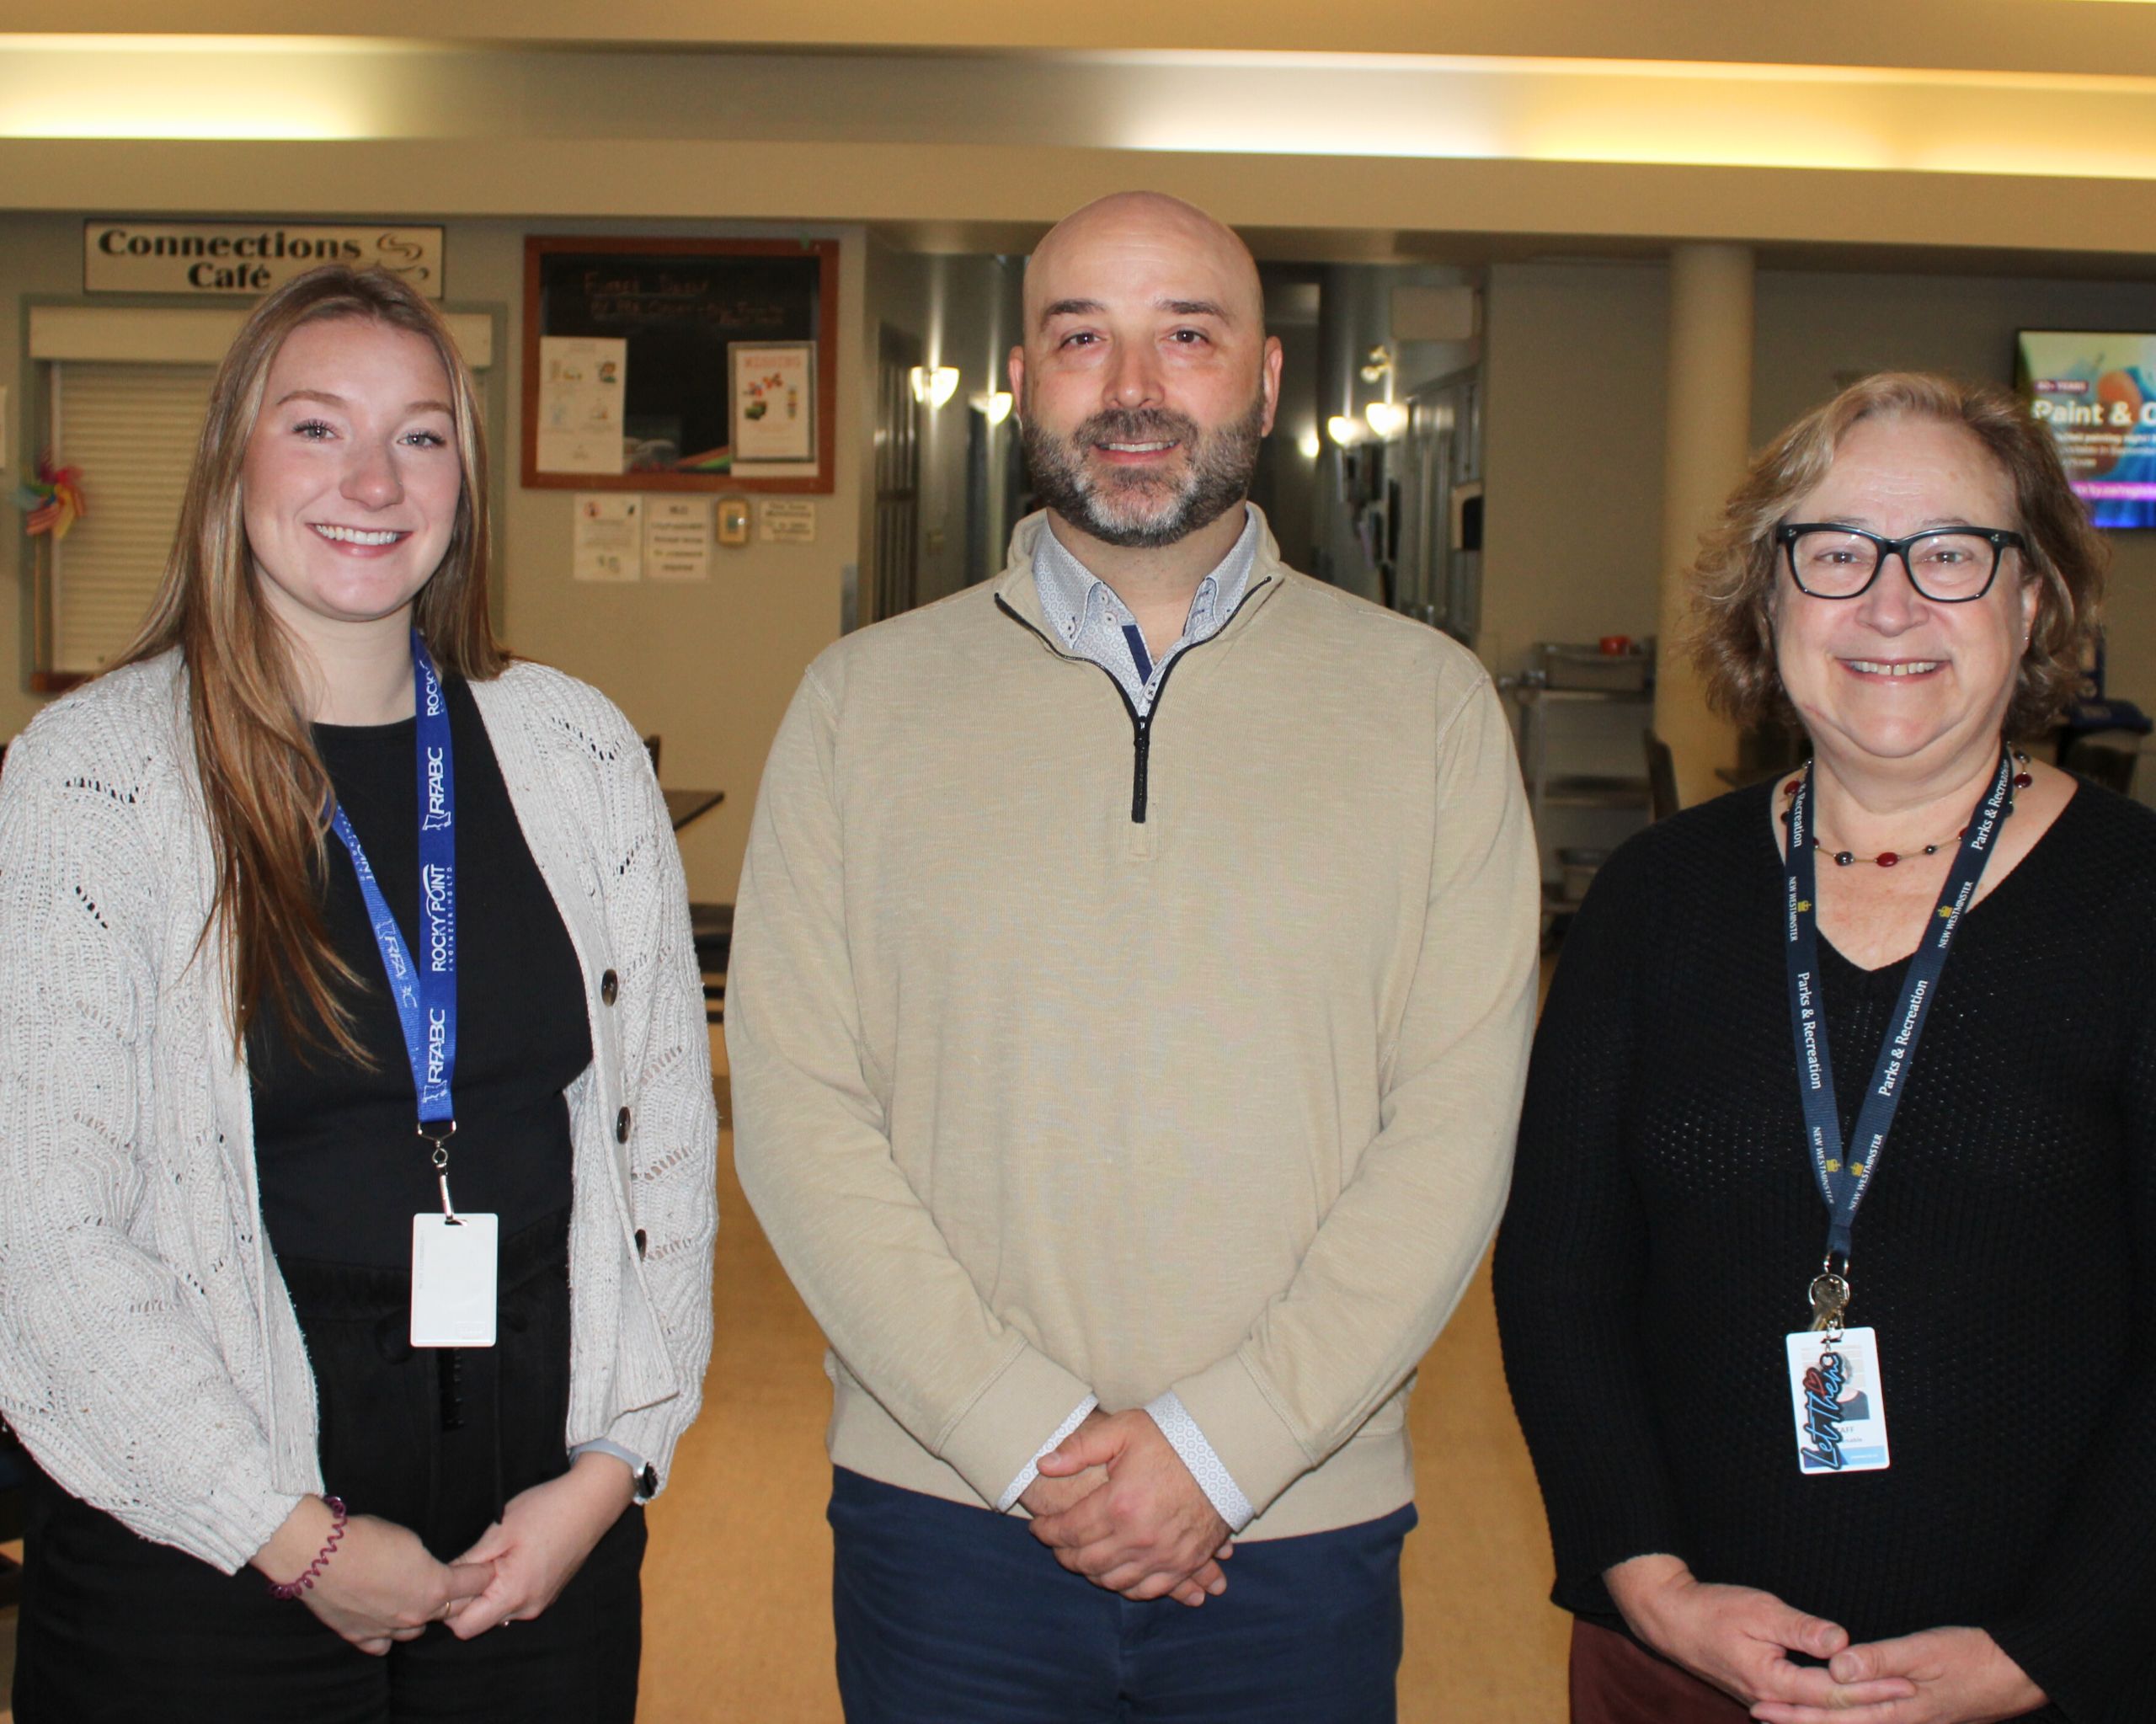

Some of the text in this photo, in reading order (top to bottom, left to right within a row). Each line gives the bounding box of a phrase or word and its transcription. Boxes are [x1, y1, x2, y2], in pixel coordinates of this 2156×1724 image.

[98, 229, 362, 259] Connections
[187, 262, 271, 290] Café
[2033, 399, 2105, 425] Paint
[2109, 400, 2132, 426] &
[428, 746, 445, 814] RFABC
[1793, 792, 1806, 848] Recreation
[1971, 819, 1993, 851] Parks
[1984, 809, 1998, 819] &
[431, 863, 446, 971] ROCKY POINT
[1789, 876, 1798, 942] NEW WESTMINSTER
[1938, 881, 1973, 948] NEW WESTMINSTER
[428, 1007, 446, 1083] RFABC
[1798, 972, 1822, 1090] Parks & Recreation
[1878, 979, 1929, 1097] Parks & Recreation
[1813, 1127, 1834, 1204] NEW WESTMINSTER
[1848, 1134, 1883, 1210] NEW WESTMINSTER
